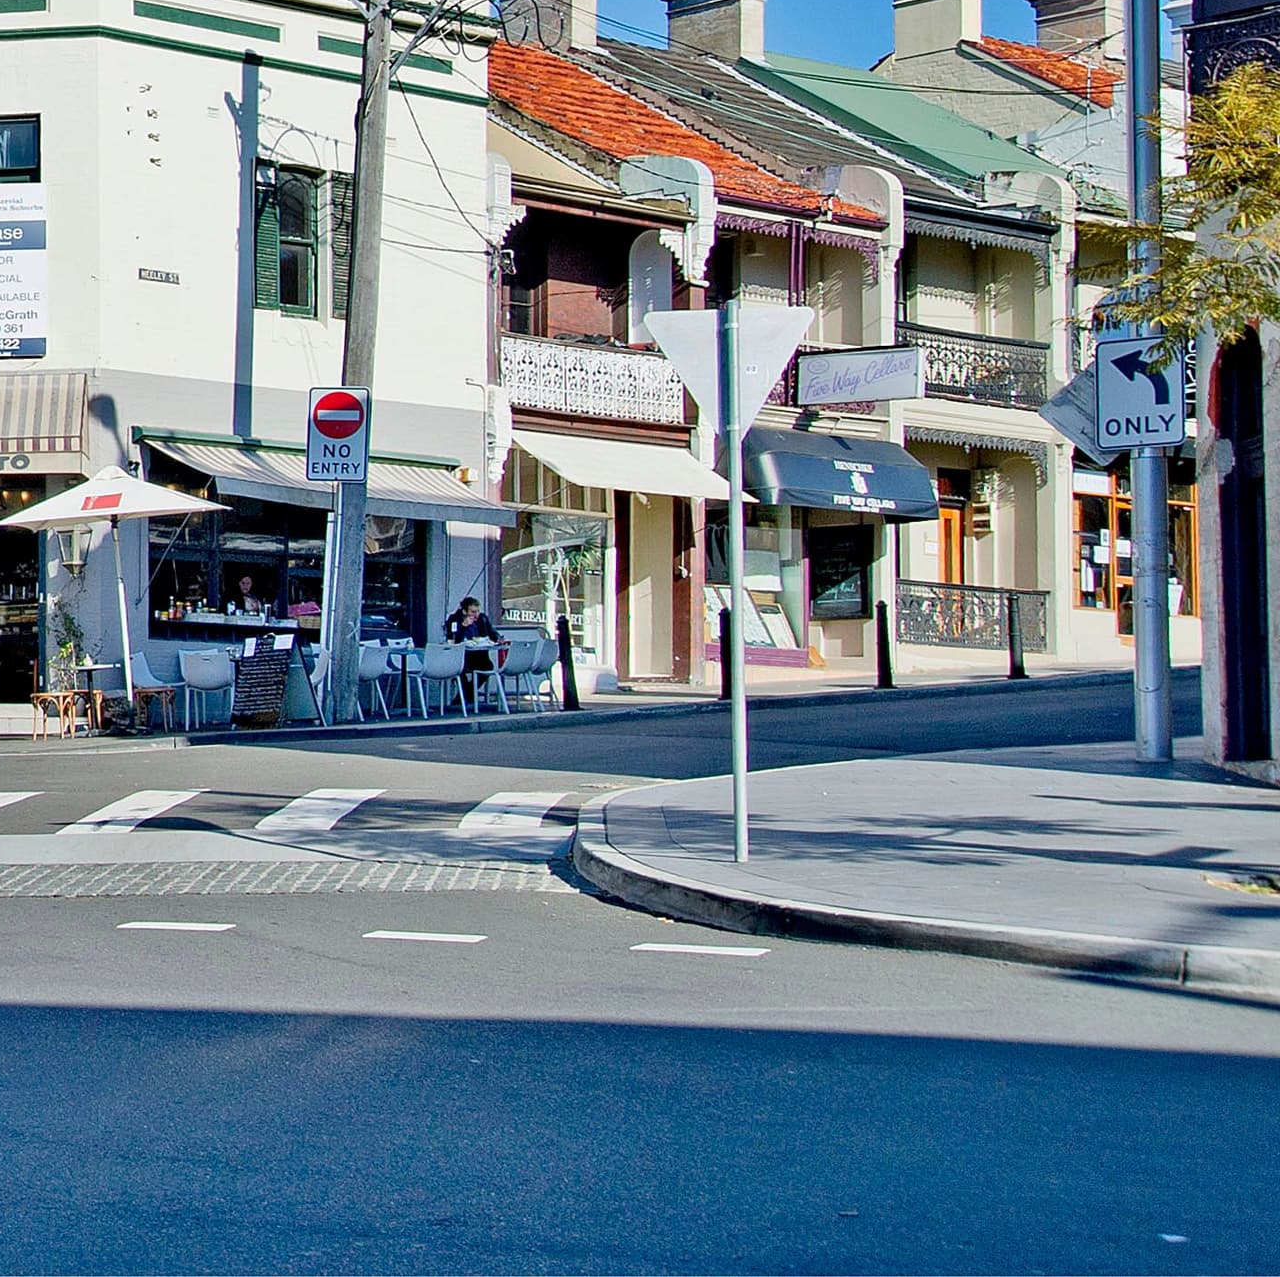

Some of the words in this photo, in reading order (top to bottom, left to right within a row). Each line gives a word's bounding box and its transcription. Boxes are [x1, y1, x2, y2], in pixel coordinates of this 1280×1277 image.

[4, 323, 23, 333] 361
[804, 376, 831, 399] Five
[832, 372, 861, 395] Way
[864, 354, 913, 384] Cellars
[1105, 414, 1176, 436] ONLY
[323, 444, 351, 458] NO
[312, 462, 360, 474] ENTRY
